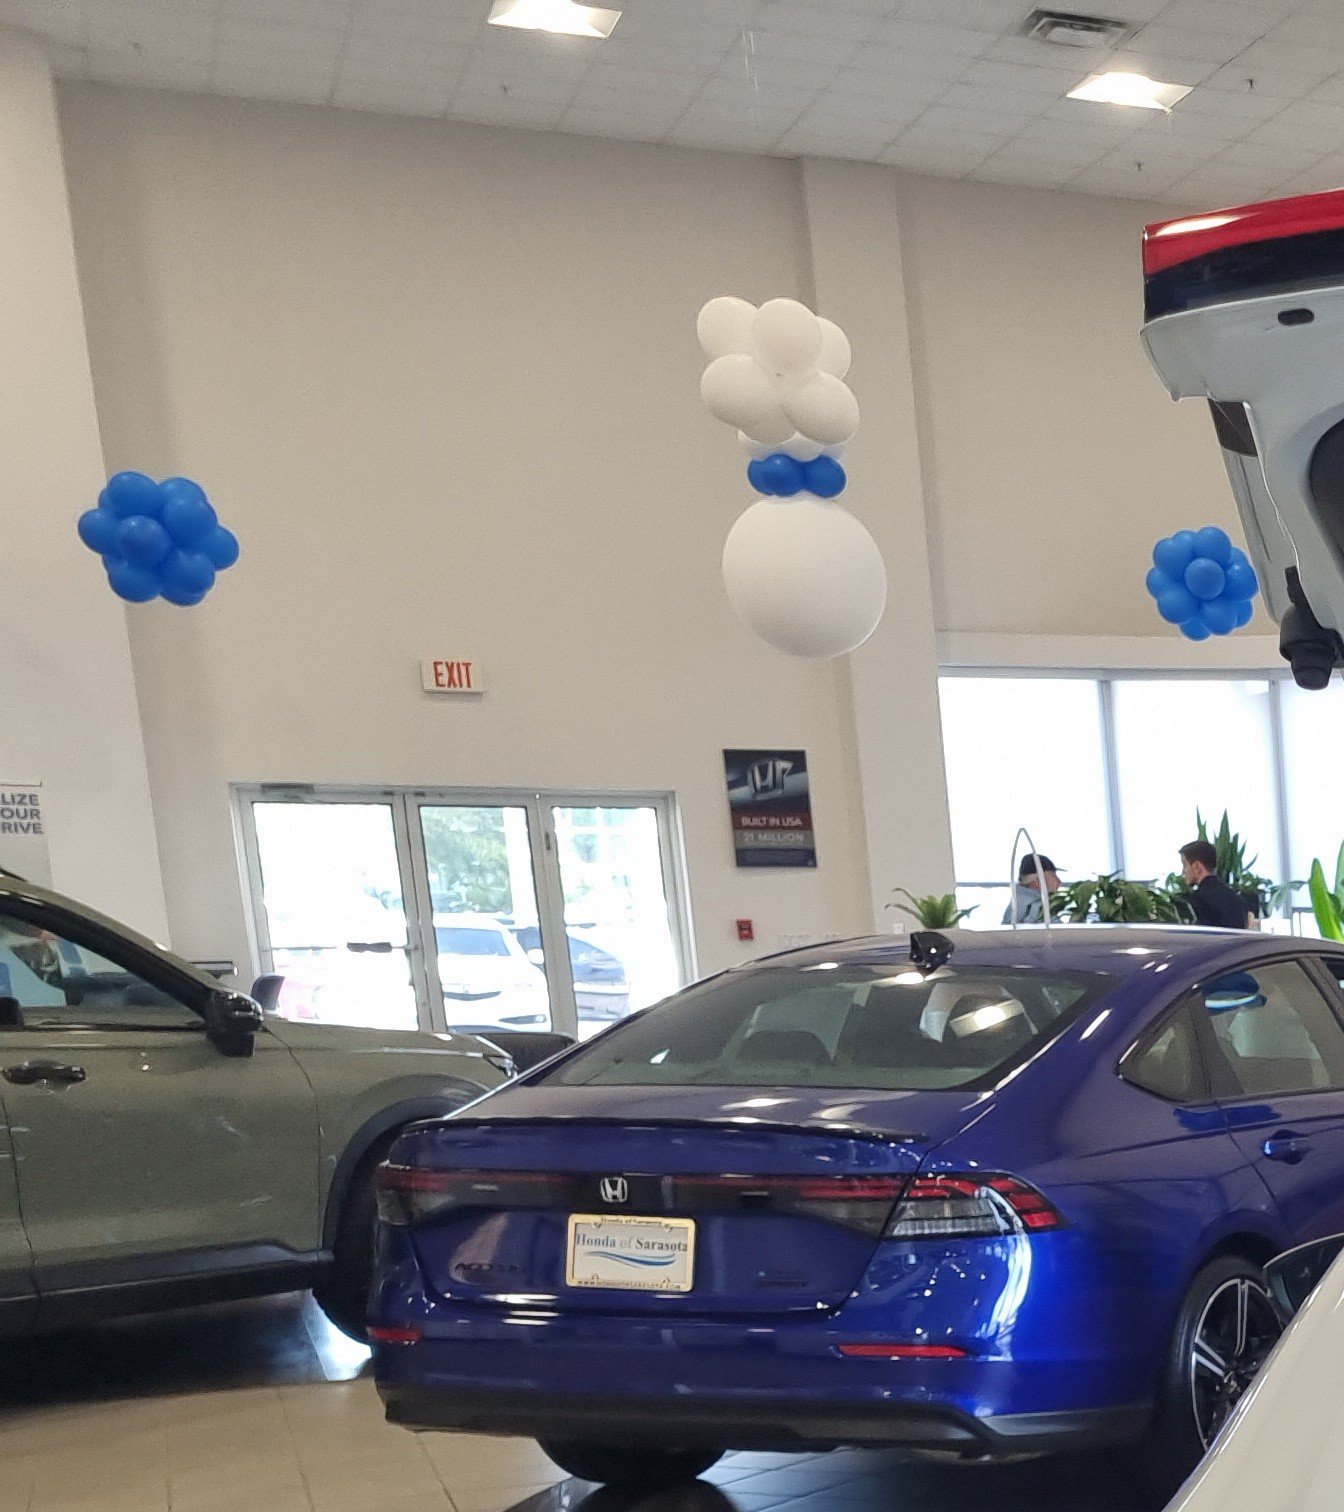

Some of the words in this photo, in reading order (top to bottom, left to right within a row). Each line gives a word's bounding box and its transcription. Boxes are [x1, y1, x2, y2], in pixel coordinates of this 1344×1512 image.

[432, 661, 472, 688] EXIT
[576, 1233, 616, 1248] Honda
[635, 1238, 688, 1252] Sarasota
